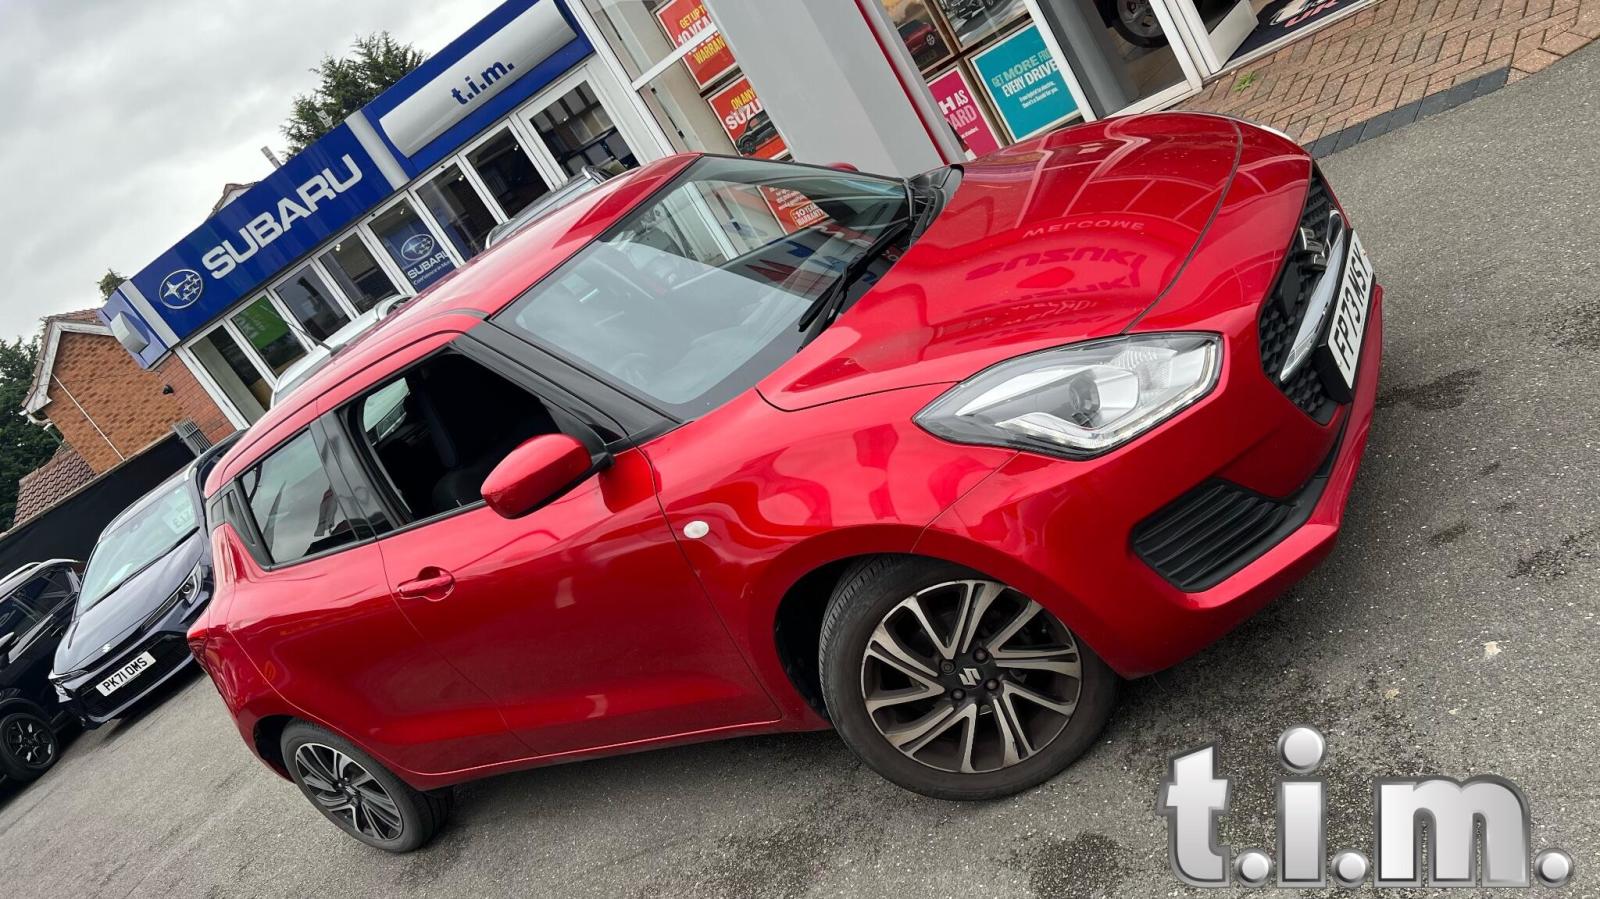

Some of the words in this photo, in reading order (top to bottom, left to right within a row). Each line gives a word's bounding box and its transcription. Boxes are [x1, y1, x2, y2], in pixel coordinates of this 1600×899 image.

[692, 36, 726, 64] WARRAN
[1003, 56, 1040, 81] MORE
[1038, 48, 1053, 64] FRO
[451, 61, 515, 105] t.i.m.
[1001, 77, 1028, 97] EVERY
[725, 98, 763, 130] SUZU
[730, 96, 742, 110] ON
[938, 95, 957, 115] H
[954, 89, 969, 107] AS
[946, 104, 977, 130] ARD
[202, 153, 363, 280] SUBARU
[1333, 285, 1361, 371] FP73
[1348, 242, 1369, 307] MSY
[102, 671, 127, 691] PK71
[124, 657, 148, 676] OMS
